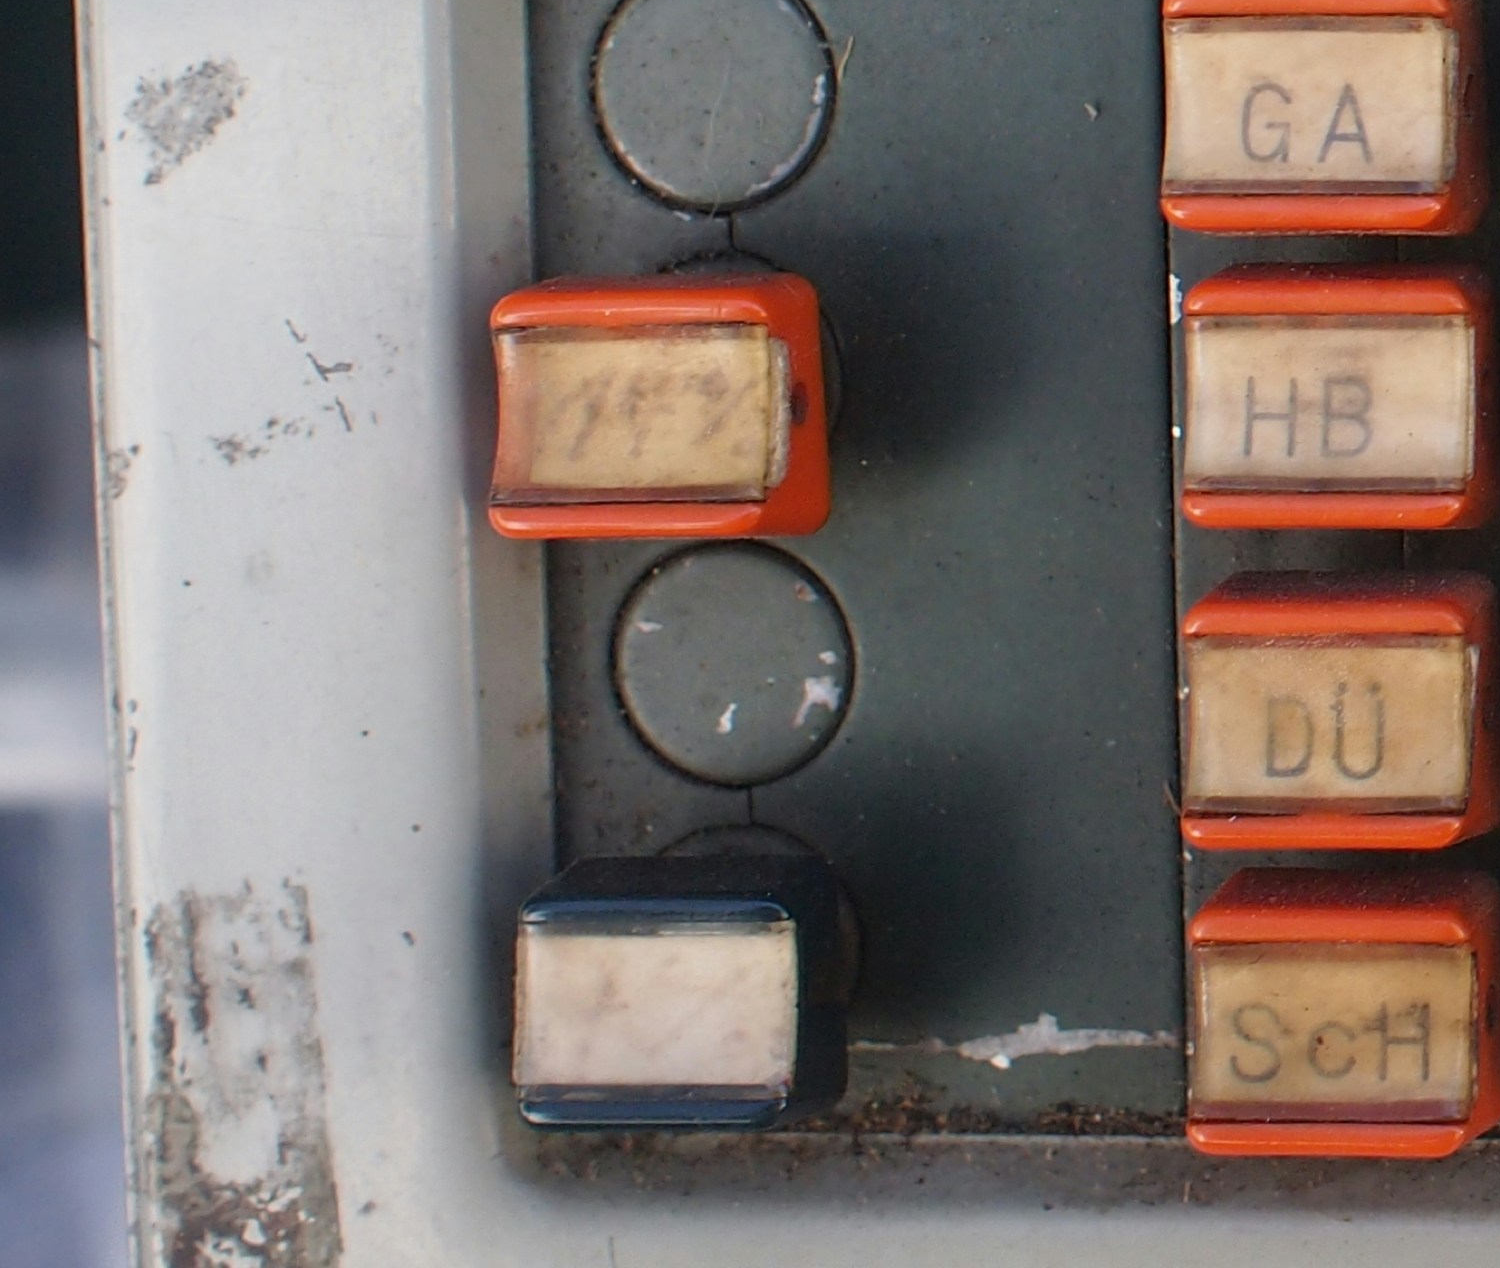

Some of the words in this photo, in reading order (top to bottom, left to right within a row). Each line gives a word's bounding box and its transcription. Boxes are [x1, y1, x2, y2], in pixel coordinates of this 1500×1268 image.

[1240, 82, 1373, 165] GA
[1242, 373, 1375, 460] HB
[1264, 679, 1386, 781] DÜ
